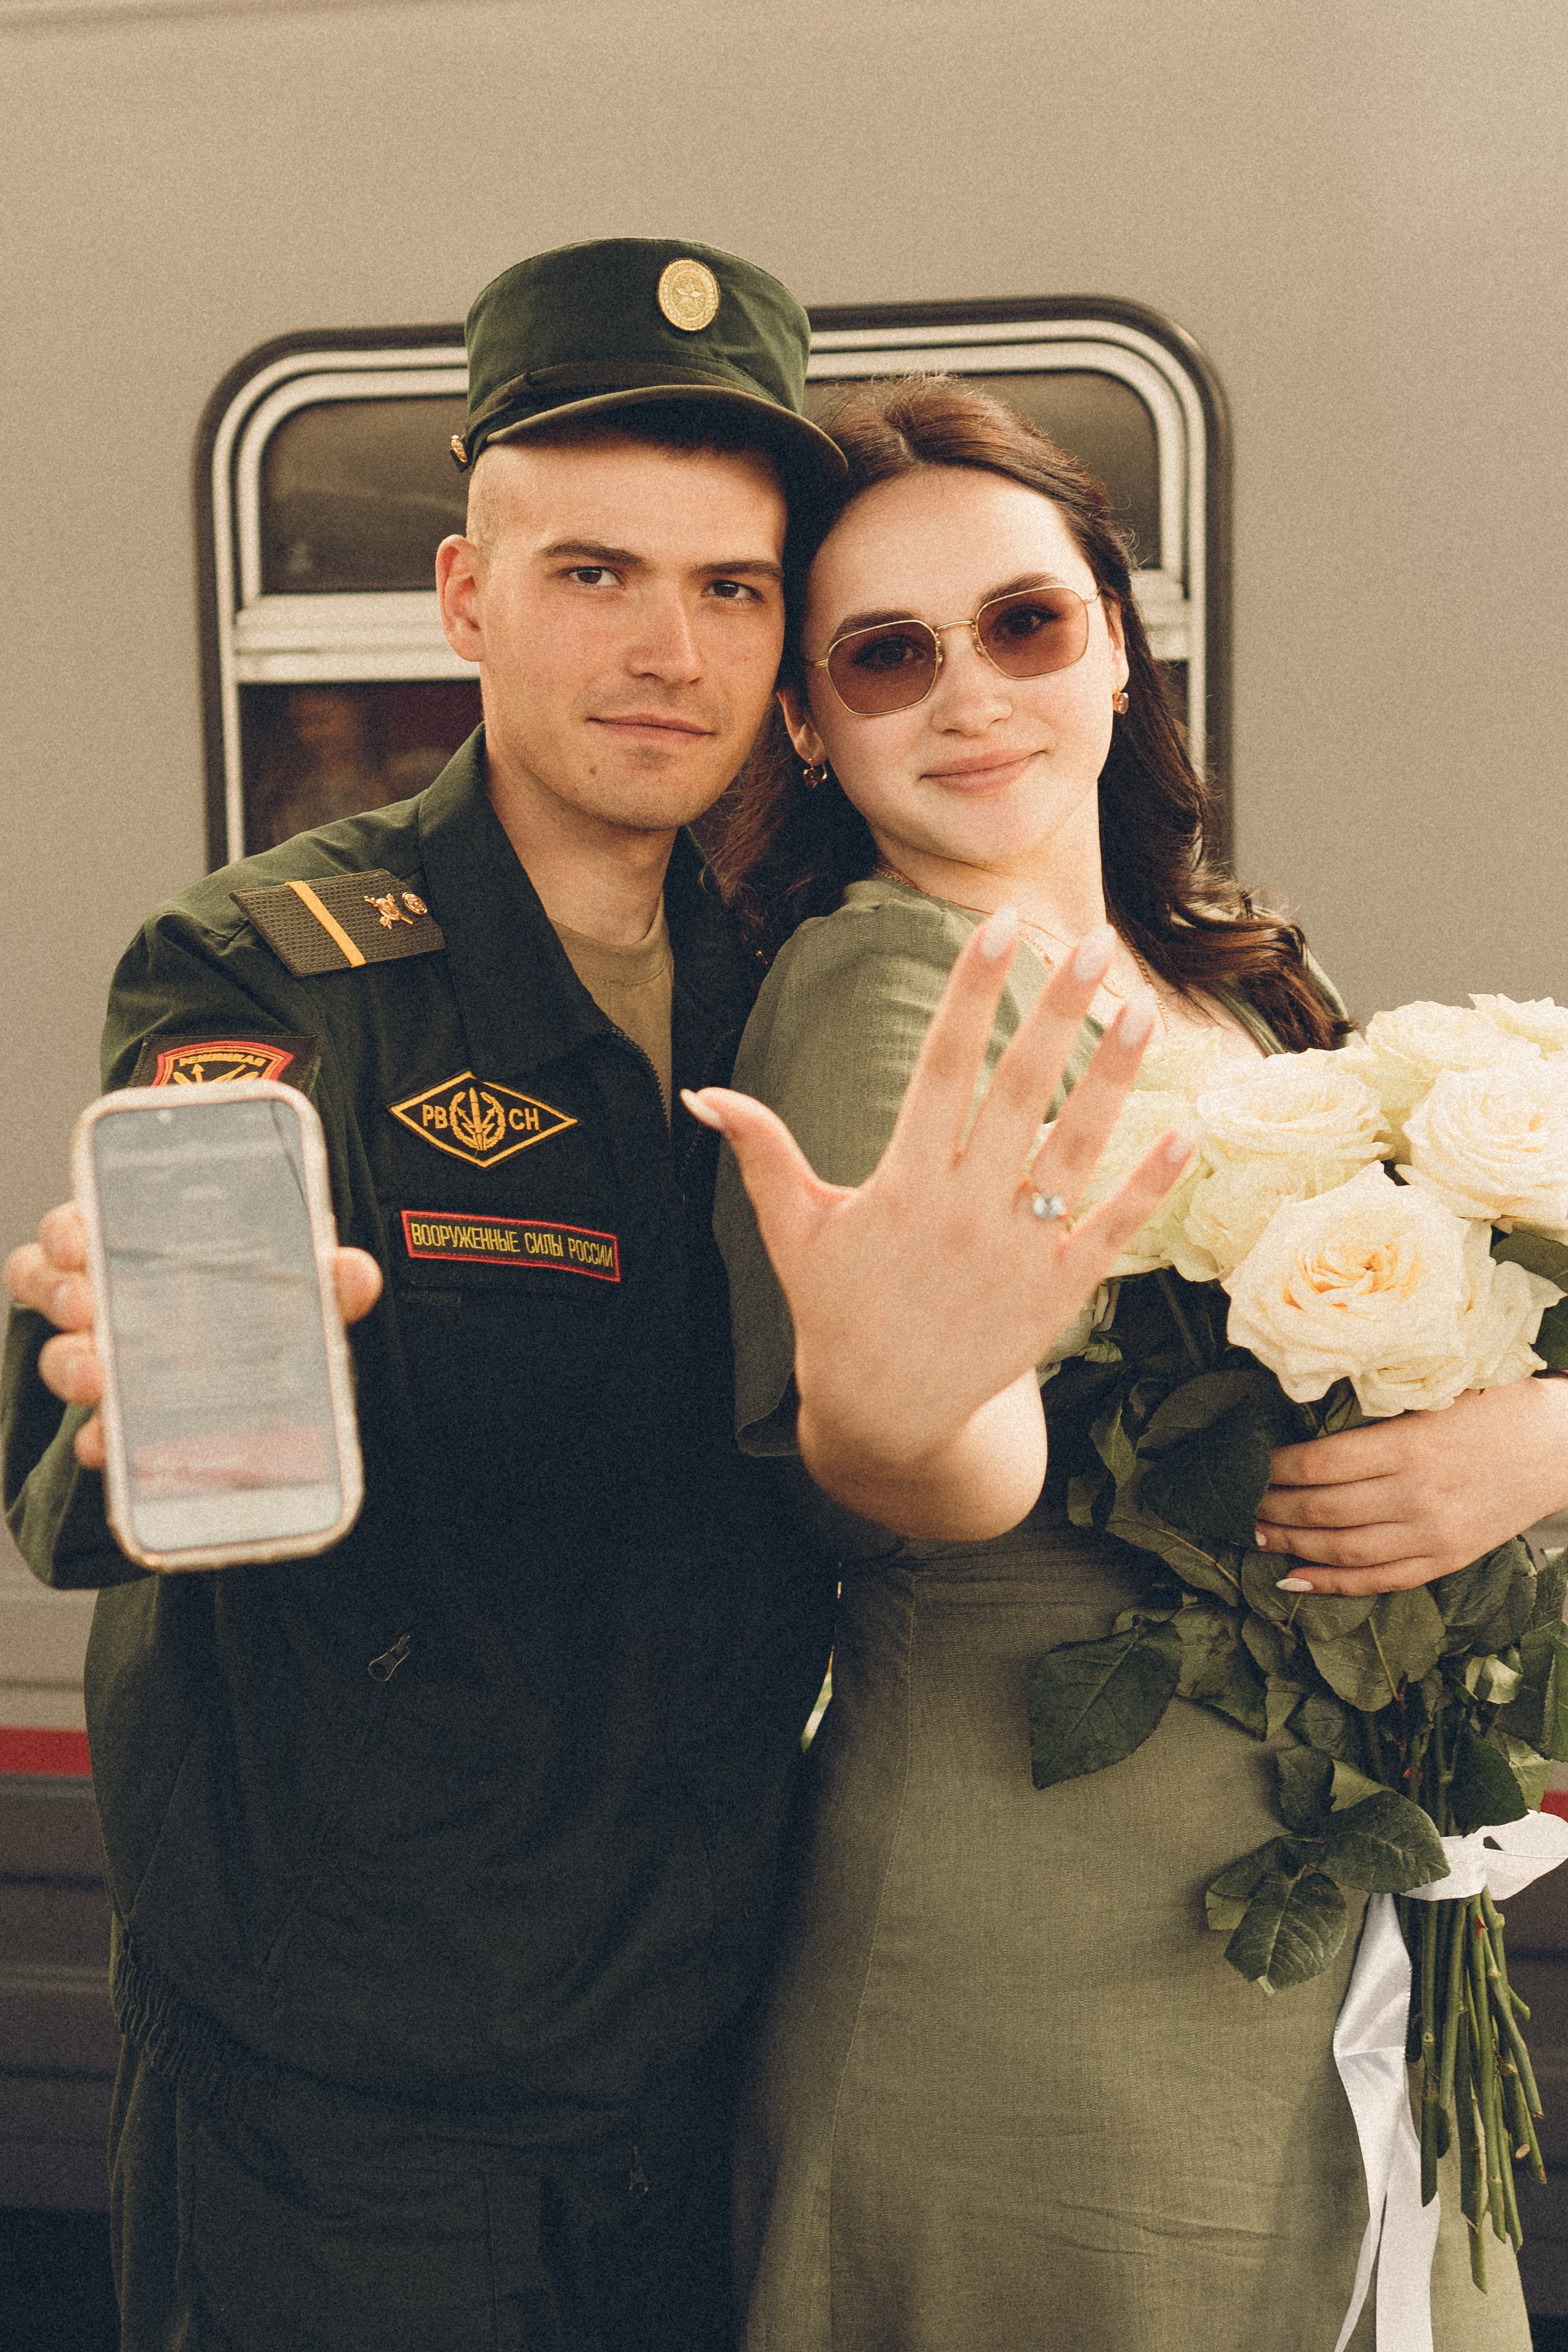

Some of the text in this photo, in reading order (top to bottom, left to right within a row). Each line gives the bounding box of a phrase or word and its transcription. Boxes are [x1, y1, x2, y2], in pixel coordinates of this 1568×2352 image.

[422, 1104, 540, 1131] РВ СН
[411, 1223, 614, 1268] ВООРУЖЕННЫЕ СИЛЫ РОССИИ
